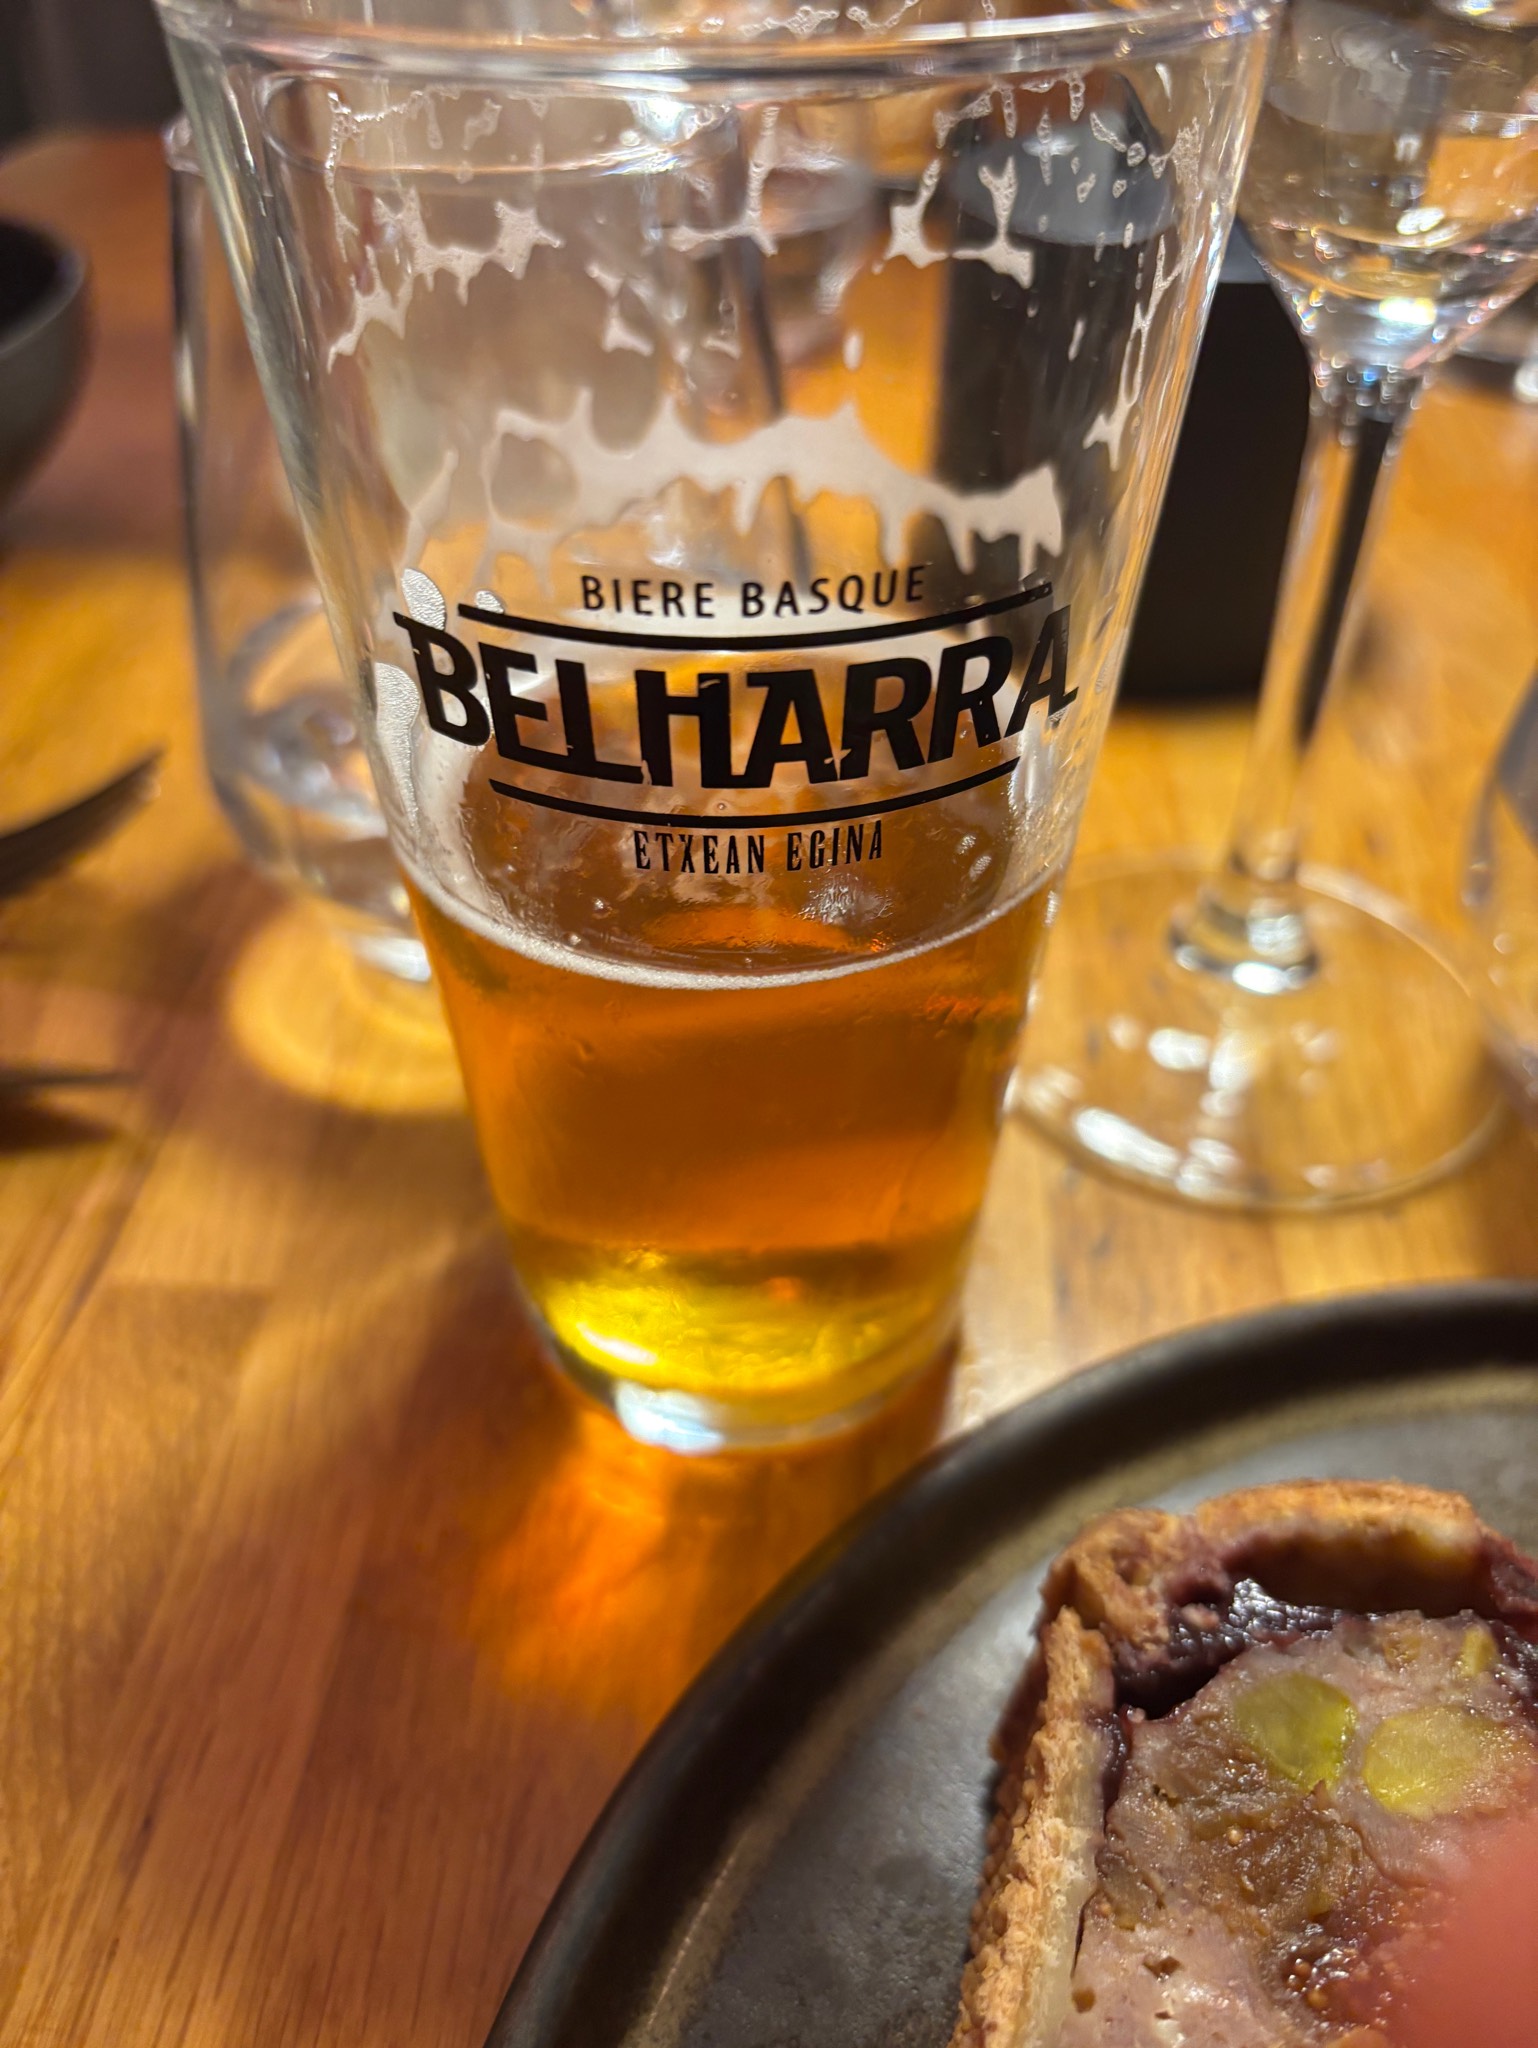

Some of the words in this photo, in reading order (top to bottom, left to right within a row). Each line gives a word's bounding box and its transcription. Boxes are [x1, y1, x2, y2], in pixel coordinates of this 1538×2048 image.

[581, 575, 715, 618] BIERE
[741, 565, 926, 617] BASQUE
[393, 604, 1079, 789] BELHARRA
[633, 829, 766, 875] ETXEAN
[786, 820, 884, 872] EGINA
